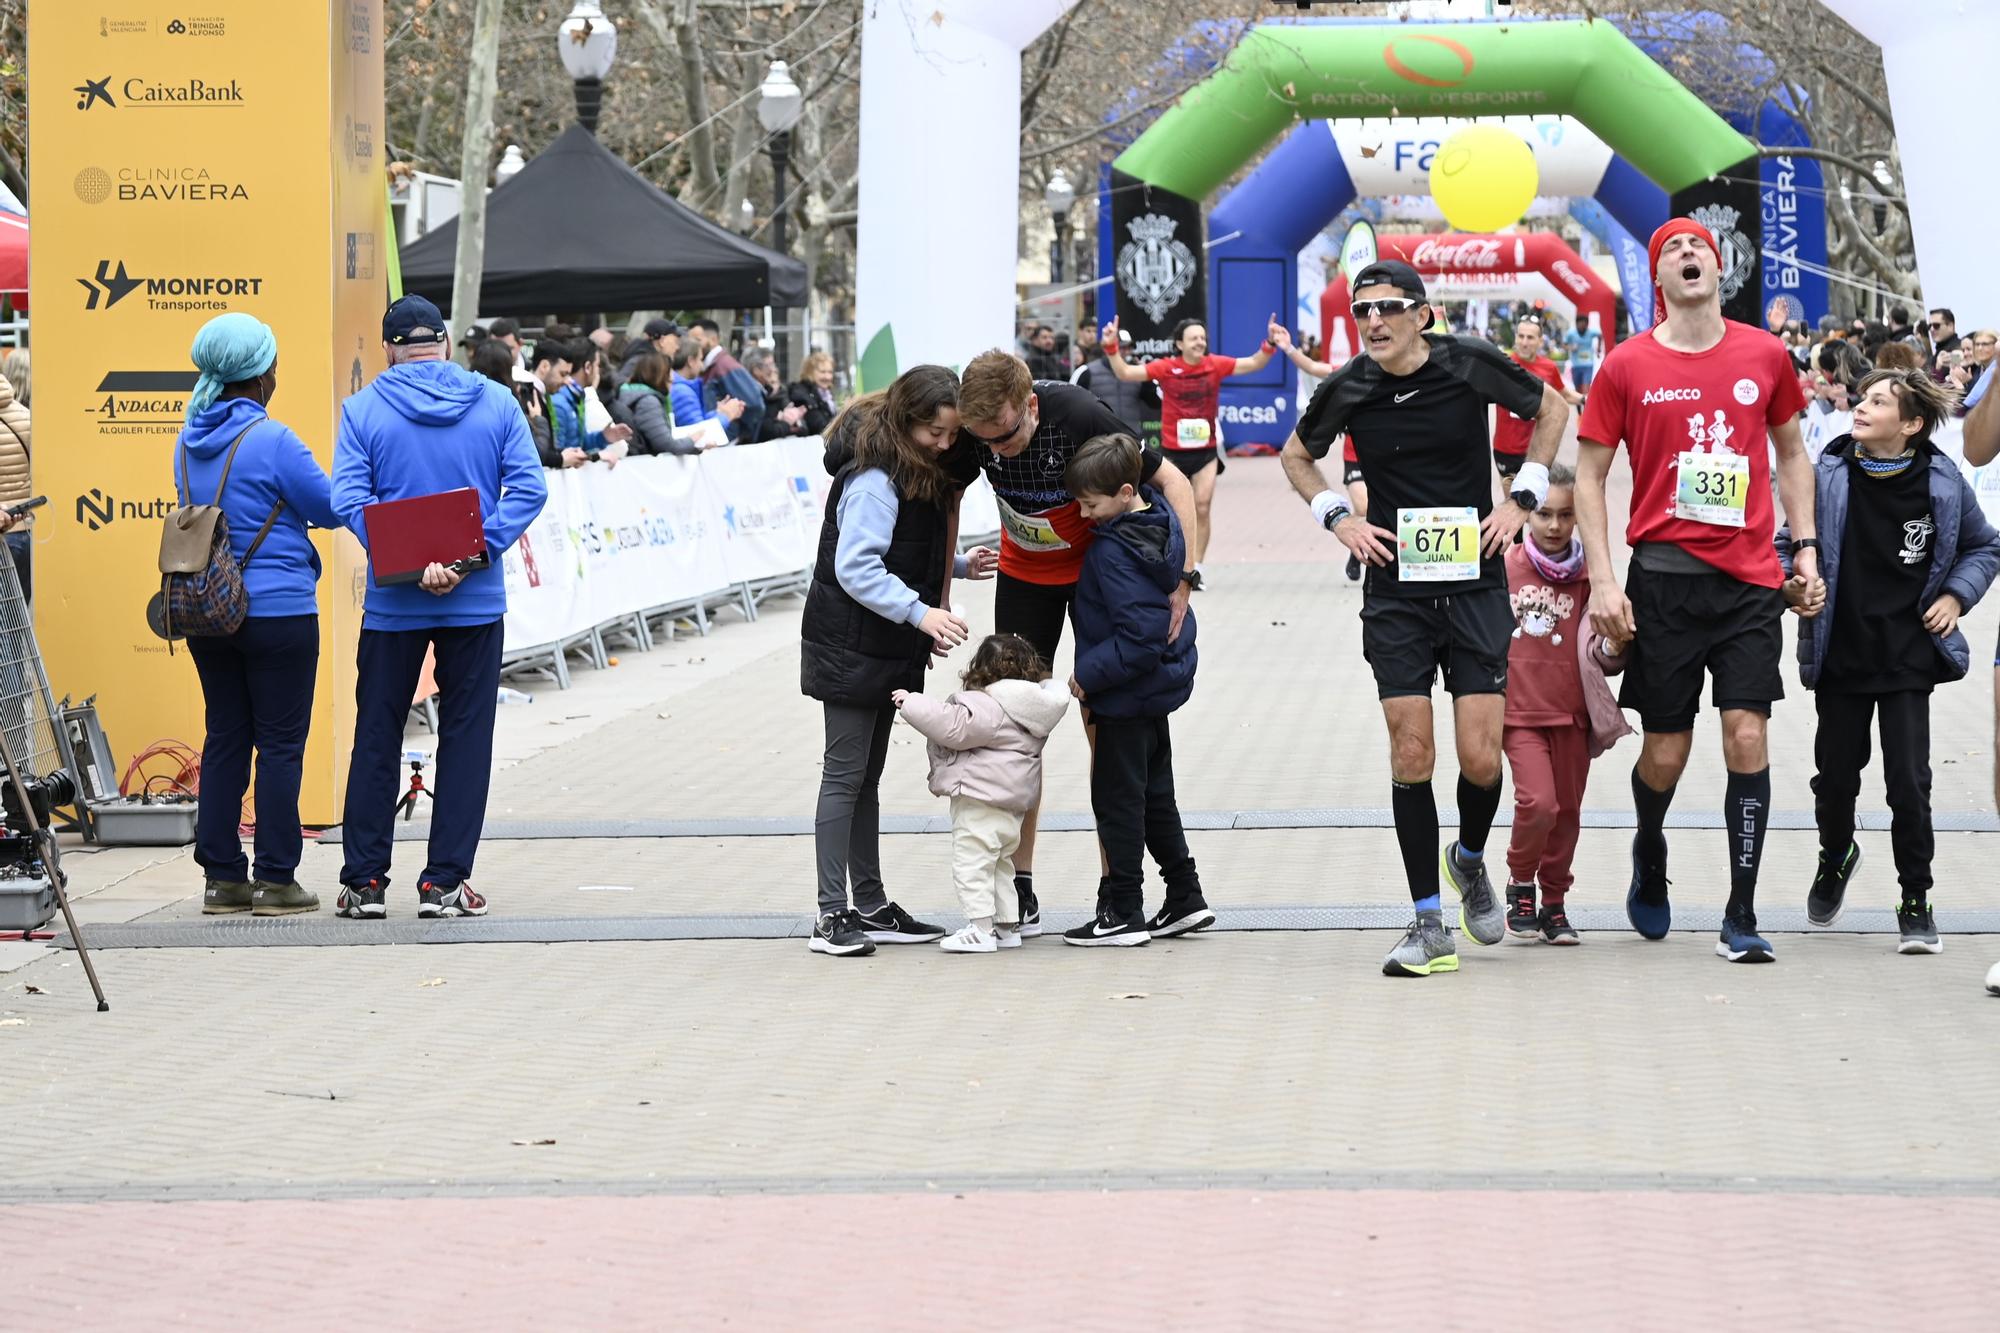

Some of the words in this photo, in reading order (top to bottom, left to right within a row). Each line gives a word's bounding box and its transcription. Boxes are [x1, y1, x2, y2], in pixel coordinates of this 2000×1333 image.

[123, 78, 244, 101] CaixaBank
[1429, 90, 1547, 105] D'ESPORTS
[118, 168, 210, 181] CLINICA
[118, 184, 249, 200] BAVIERA
[1762, 190, 1780, 290] CLNICA
[1412, 239, 1503, 268] Coca-Cola
[147, 278, 262, 295] MONFORT
[148, 299, 228, 312] Transportes
[1641, 387, 1702, 406] Adecco
[99, 394, 183, 418] ANDACAR
[1695, 471, 1736, 497] 331
[121, 498, 180, 519] nutr
[1704, 497, 1729, 507] XIMO
[1415, 527, 1460, 553] 671
[1425, 554, 1453, 563] JUAN
[133, 644, 167, 653] Televisió
